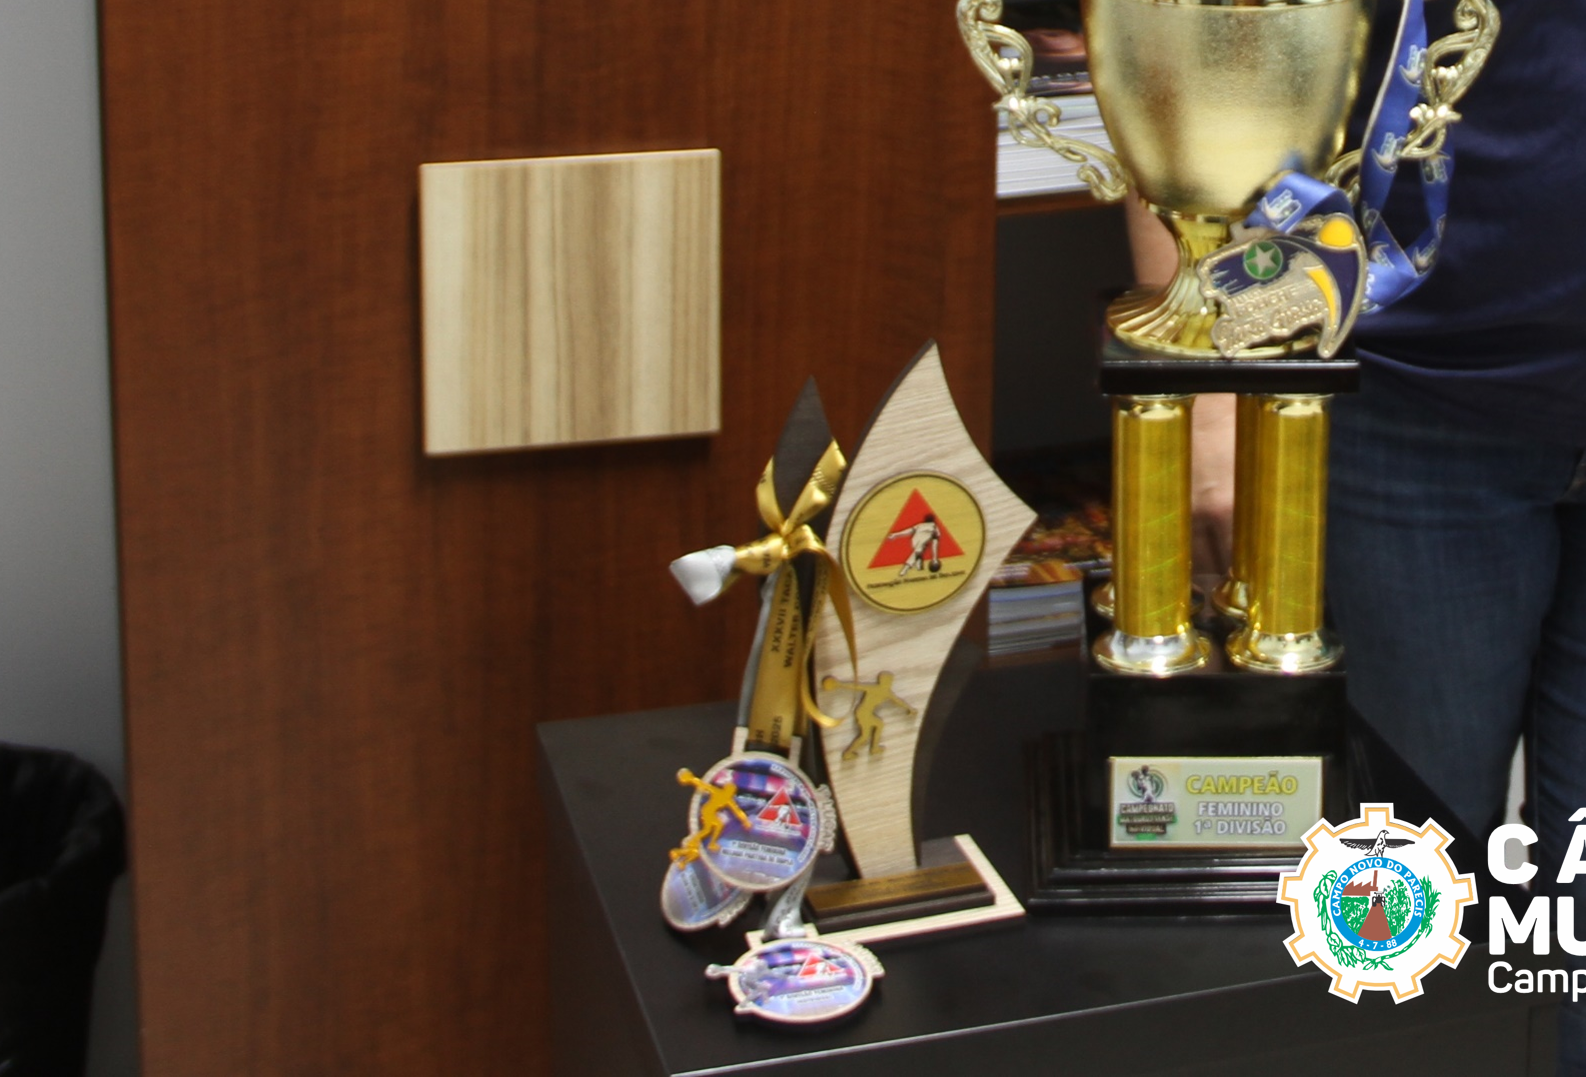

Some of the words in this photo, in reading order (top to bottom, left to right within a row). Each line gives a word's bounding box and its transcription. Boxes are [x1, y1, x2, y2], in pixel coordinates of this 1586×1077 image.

[1186, 771, 1298, 795] CAMPEÃO
[1198, 802, 1284, 817] FEMININO
[1216, 817, 1287, 835] DIVISÃO
